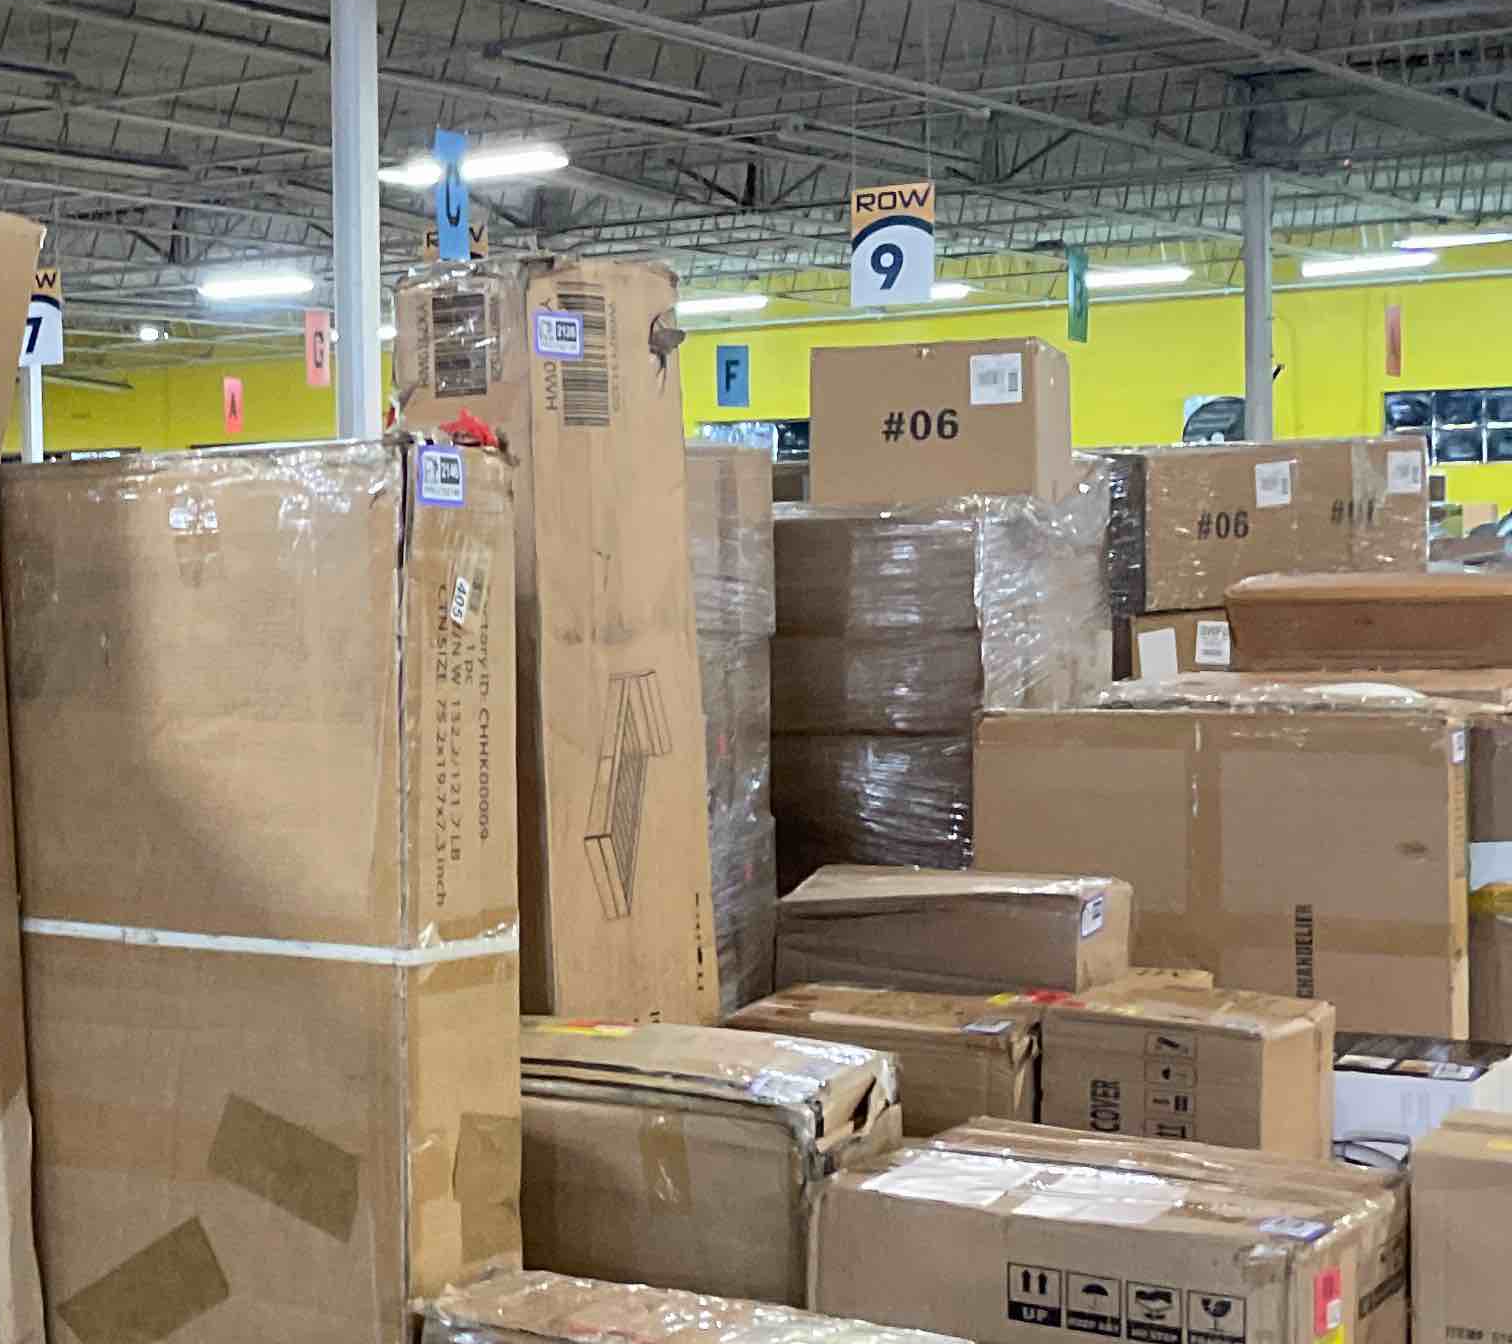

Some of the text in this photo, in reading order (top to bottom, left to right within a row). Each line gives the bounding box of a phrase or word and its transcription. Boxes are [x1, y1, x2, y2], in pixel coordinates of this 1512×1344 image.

[854, 184, 934, 215] ROW
[869, 241, 905, 291] 9
[722, 357, 742, 394] F
[880, 408, 960, 442] #06
[1195, 510, 1251, 541] #06
[451, 583, 467, 619] 405
[433, 857, 447, 907] inch
[1090, 1079, 1121, 1133] COVER
